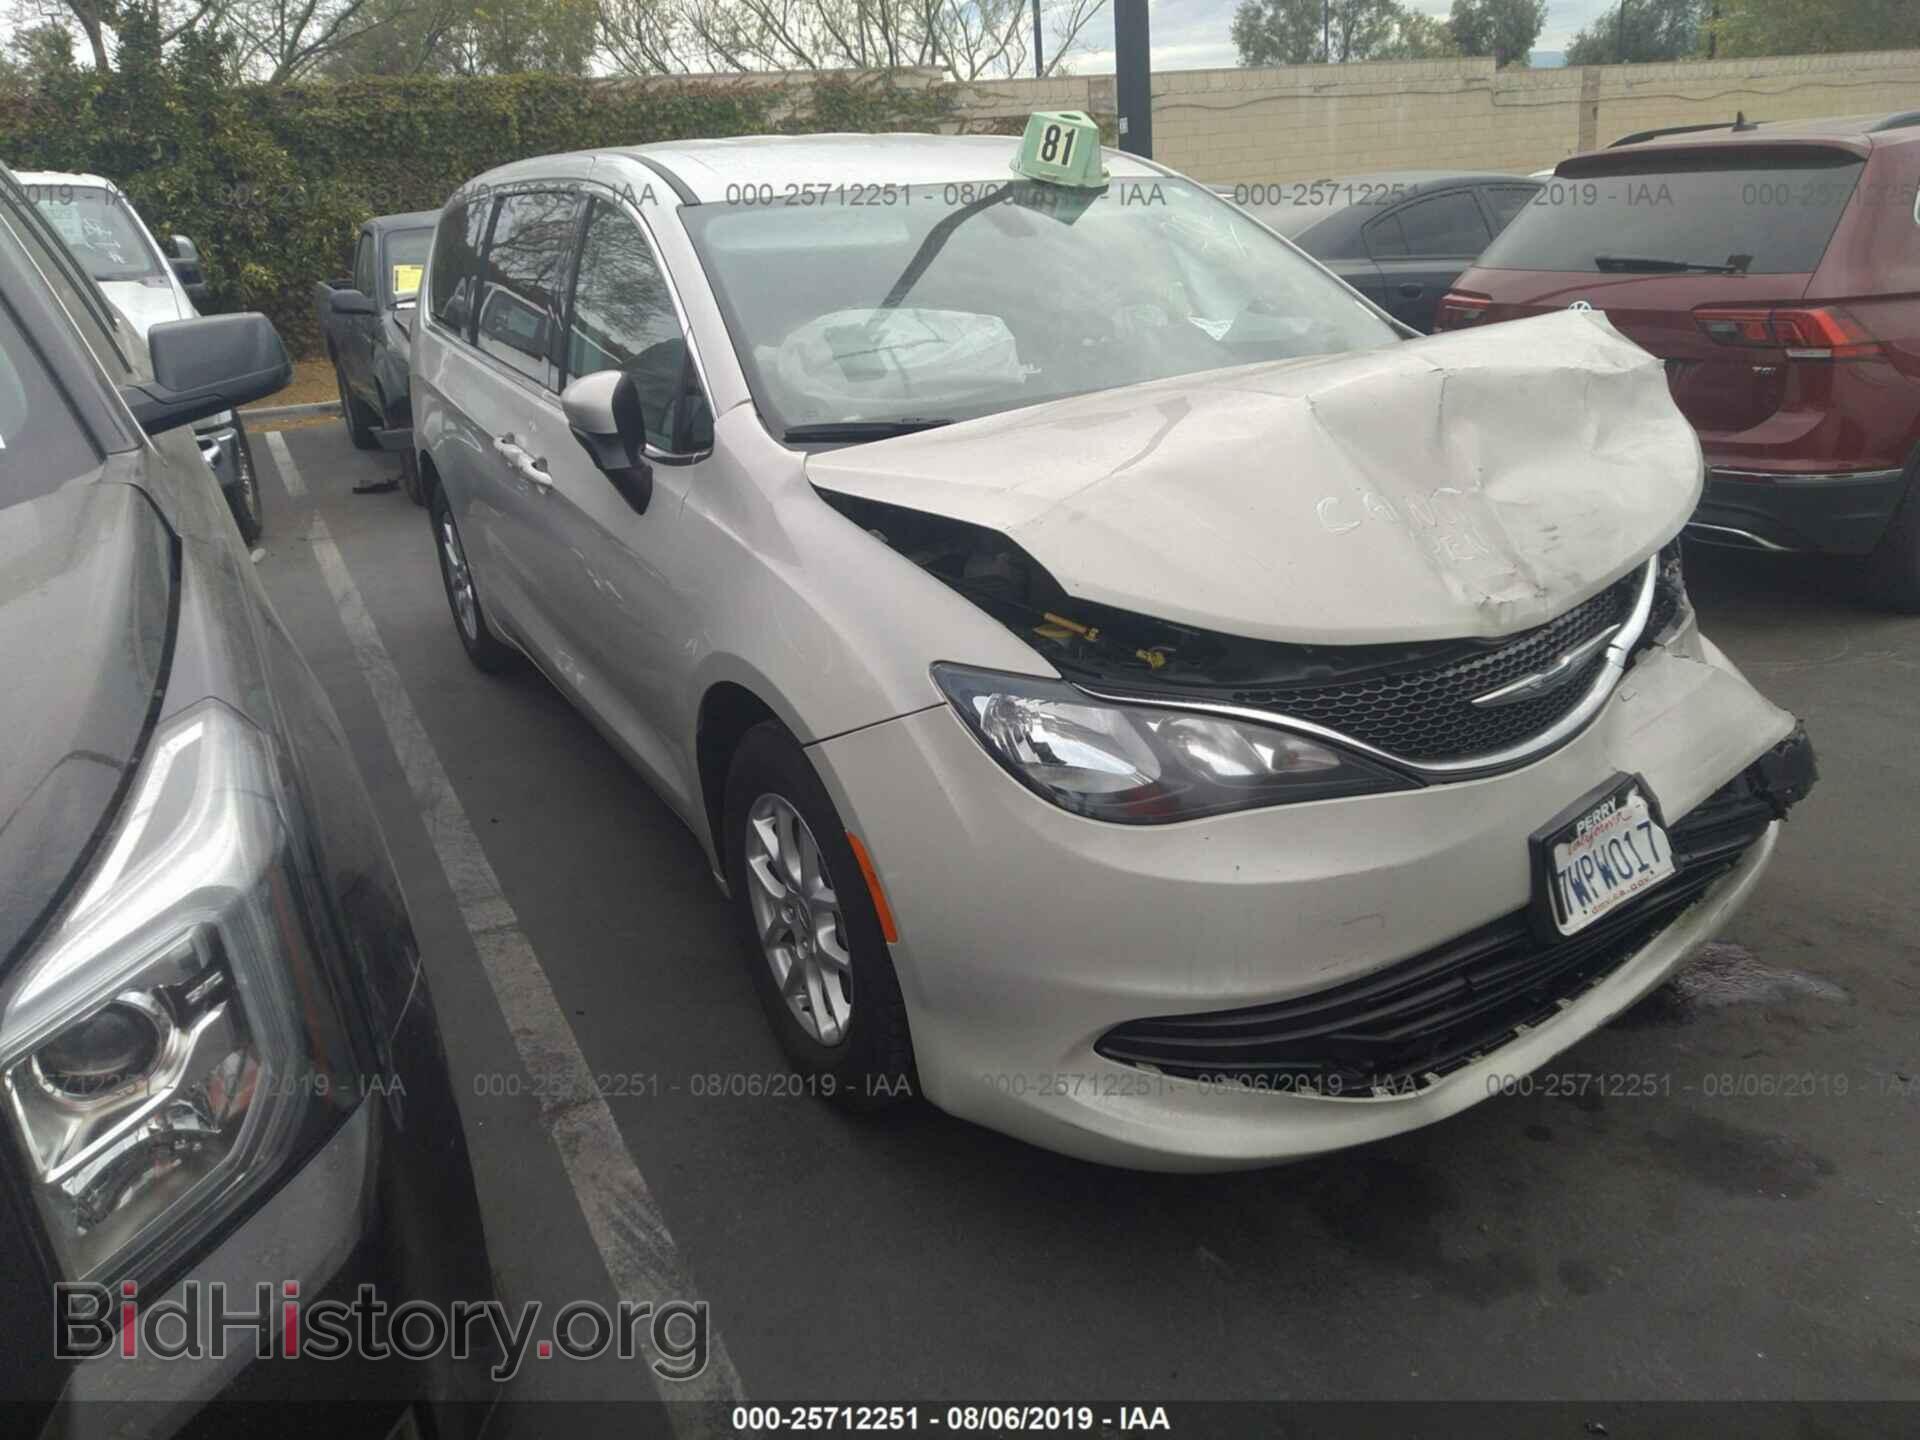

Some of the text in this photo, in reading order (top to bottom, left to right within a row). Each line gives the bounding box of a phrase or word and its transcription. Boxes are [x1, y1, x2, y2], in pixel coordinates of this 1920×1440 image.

[1040, 124, 1076, 166] 81
[1577, 795, 1616, 836] PERRY
[1557, 820, 1661, 916] 7WPW017
